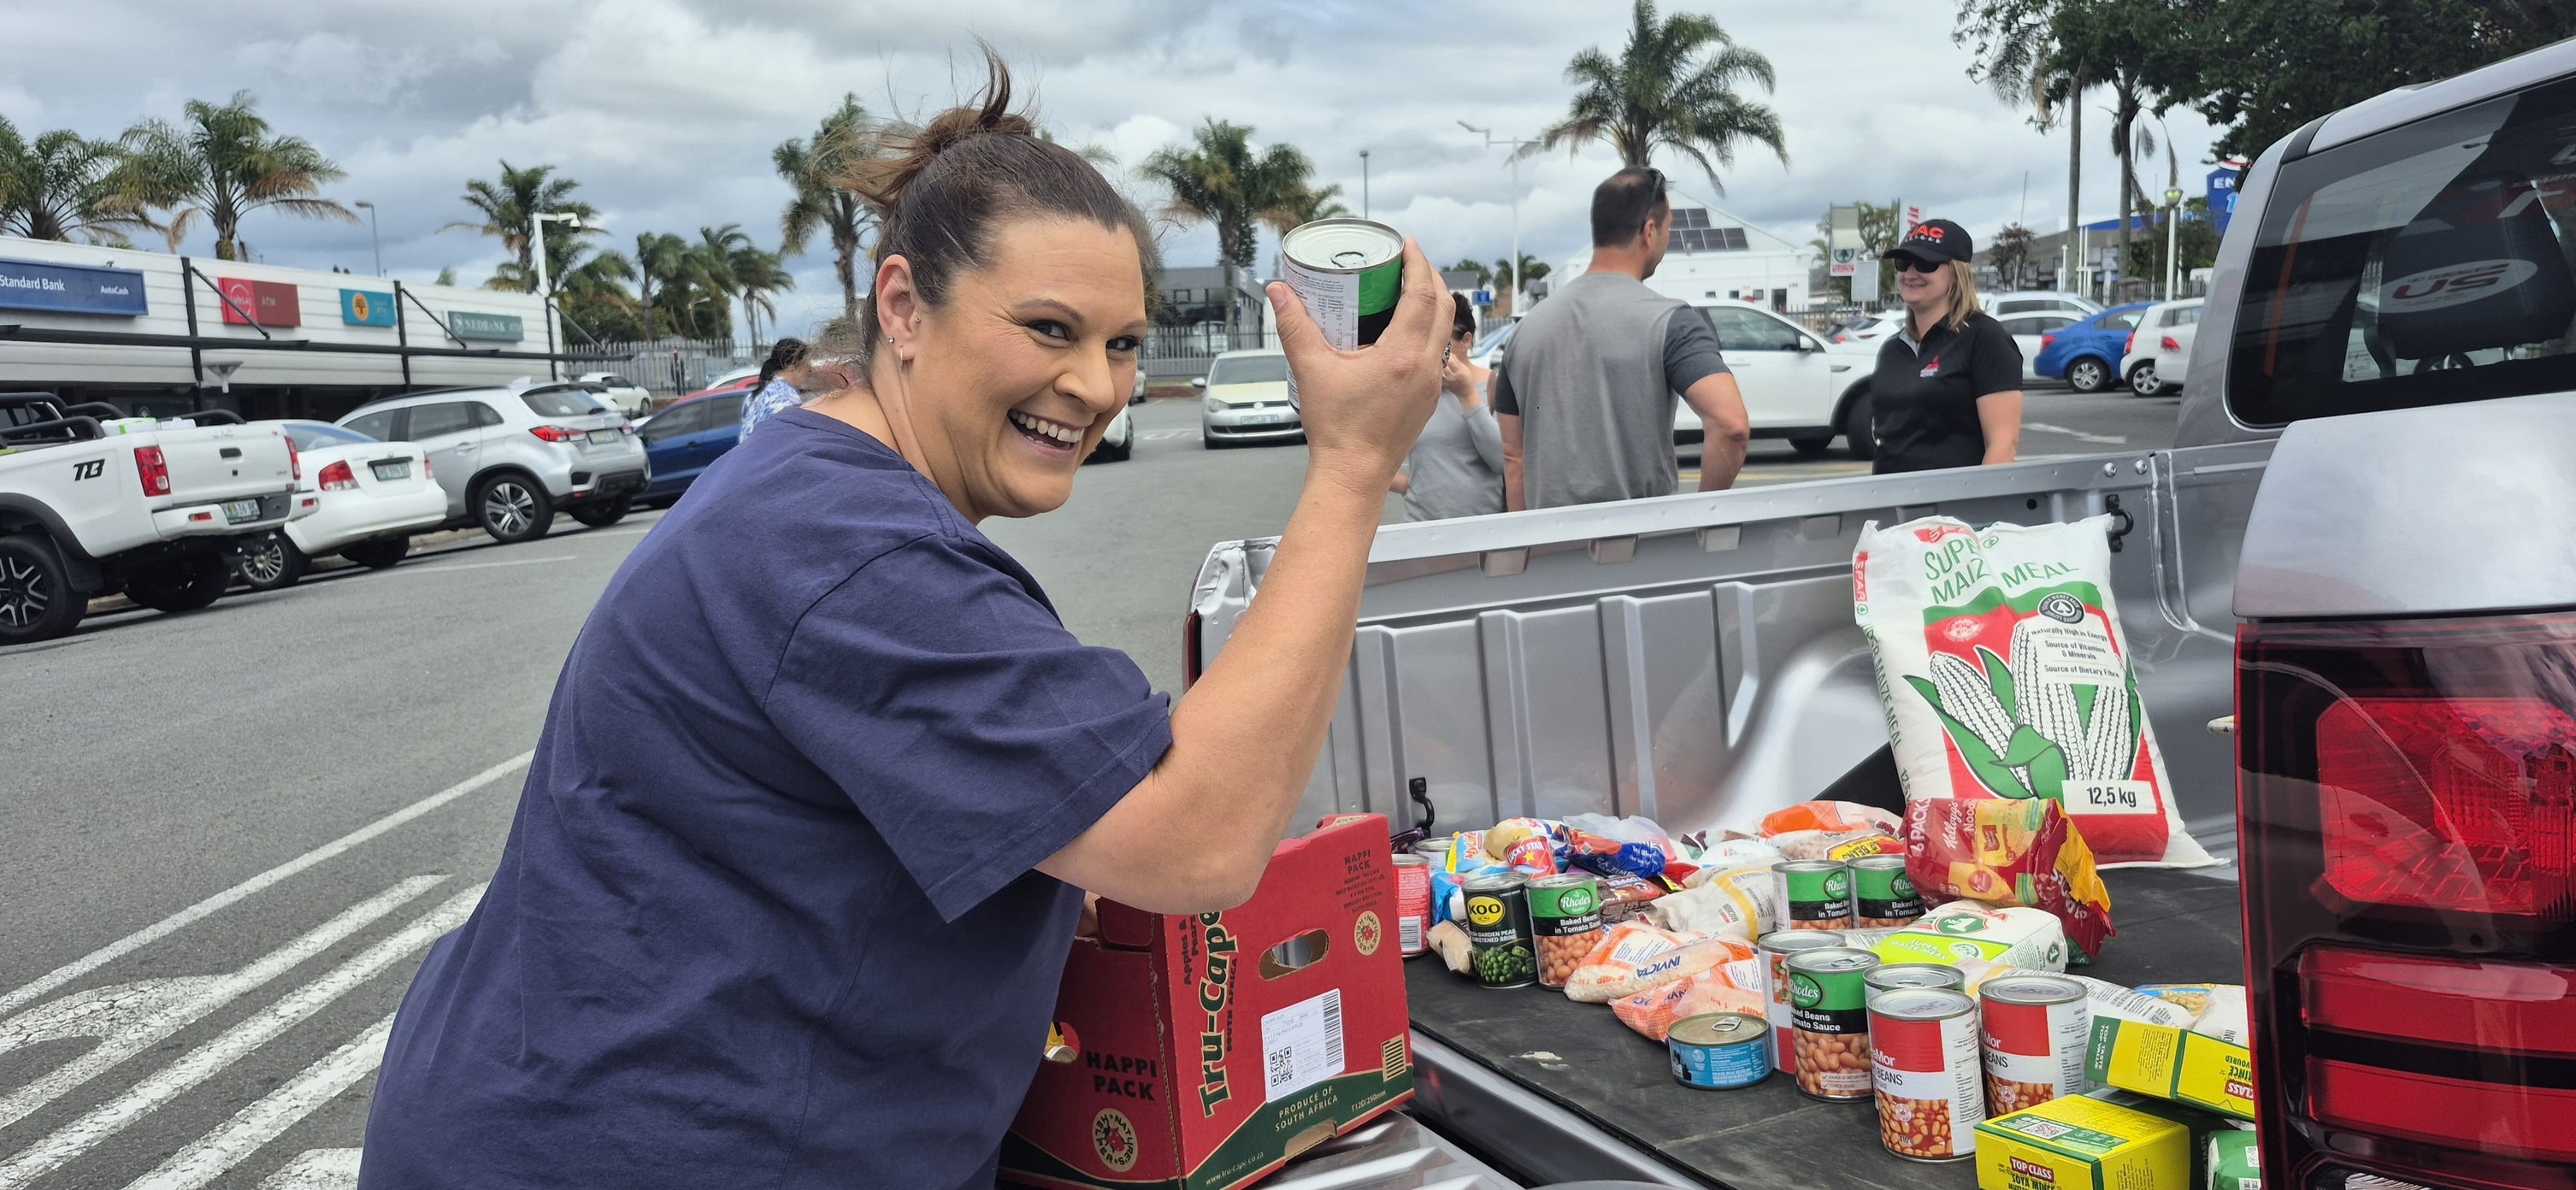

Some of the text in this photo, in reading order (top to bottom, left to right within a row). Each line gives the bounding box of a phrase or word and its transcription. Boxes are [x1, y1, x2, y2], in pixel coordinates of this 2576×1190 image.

[0, 274, 66, 292] Standard Bank
[100, 285, 129, 296] AutoCash
[464, 318, 506, 332] NEDBANK
[1854, 560, 1866, 600] SPAR
[2000, 562, 2079, 588] MEAL
[2031, 627, 2063, 636] Naturally
[2088, 631, 2107, 642] Energy
[2068, 651, 2096, 660] Minerals
[2078, 643, 2106, 653] Vitamins
[2044, 664, 2068, 673] Source
[2079, 666, 2102, 676] Dietary
[2103, 669, 2119, 678] Fibre
[2087, 786, 2137, 808] 12,5 kg
[1942, 801, 1962, 849] Kellogg's
[1345, 849, 1371, 865] HAPPI
[1508, 841, 1544, 862] LUCKY STAR
[1347, 860, 1370, 874] PACK
[1469, 904, 1500, 916] KOO
[1560, 894, 1591, 908] Rhodes
[1824, 901, 1842, 910] Baked
[1892, 900, 1913, 909] Baked
[1189, 915, 1199, 957] Pears
[1182, 932, 1192, 985] Apples
[1918, 948, 1947, 960] MEAL
[1636, 955, 1681, 979] INVICTA
[1228, 958, 1238, 1005] AFRICA
[1198, 911, 1239, 1118] Tru-Cape
[1805, 1010, 1830, 1022] Beans
[1813, 1022, 1841, 1032] Sauce
[1086, 1051, 1157, 1078] HAPPI
[1877, 1069, 1903, 1087] BEANS
[1093, 1075, 1154, 1101] PACK
[1278, 1086, 1333, 1118] PRODUCE OF
[1275, 1095, 1338, 1132] SOUTH AFRICA
[1094, 1114, 1113, 1163] HELPER
[2011, 1158, 2052, 1180] TOP CLASS
[2012, 1172, 2030, 1187] SOYA
